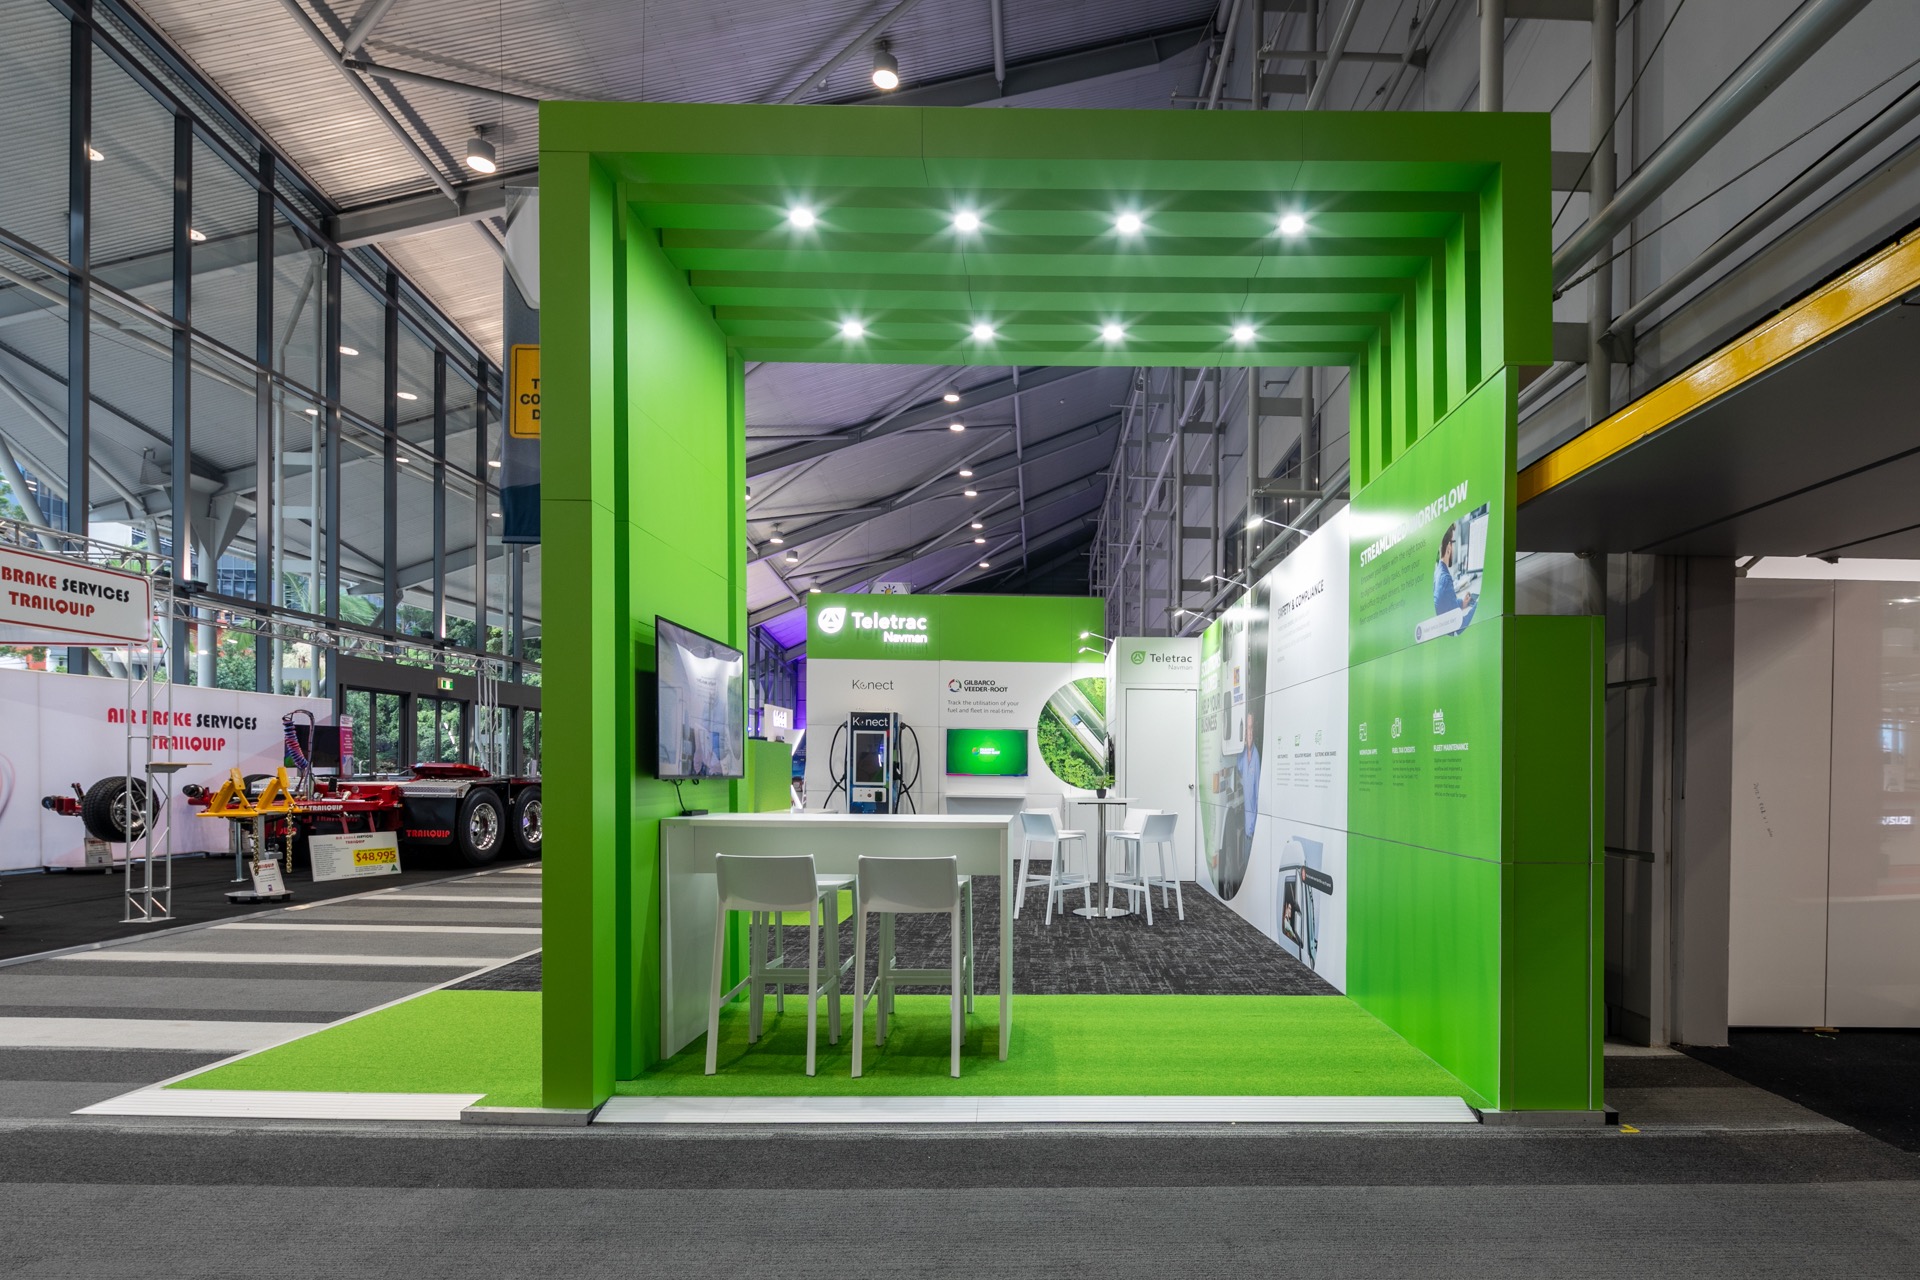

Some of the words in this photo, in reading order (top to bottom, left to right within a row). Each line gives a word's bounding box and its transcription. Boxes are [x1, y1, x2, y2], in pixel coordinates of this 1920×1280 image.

[532, 378, 540, 390] T
[520, 394, 540, 405] CO
[532, 409, 540, 420] D
[1360, 520, 1407, 568] STREAMLINED
[1408, 480, 1469, 534] WORKFLOW
[2, 566, 57, 589] BRAKE
[62, 578, 130, 602] SERVICES
[1296, 579, 1324, 608] COMPLIANCE
[8, 590, 95, 617] TRAILQUIP
[851, 612, 927, 630] Teletrac
[884, 631, 928, 643] Navman
[1150, 653, 1192, 663] Teletrac
[108, 708, 136, 724] AIR
[196, 714, 257, 730] SERVICES
[852, 716, 888, 726] Knect
[152, 735, 226, 751] TRAILQUIP
[406, 830, 450, 838] TRAILQUIP
[356, 850, 396, 862] $48,995
